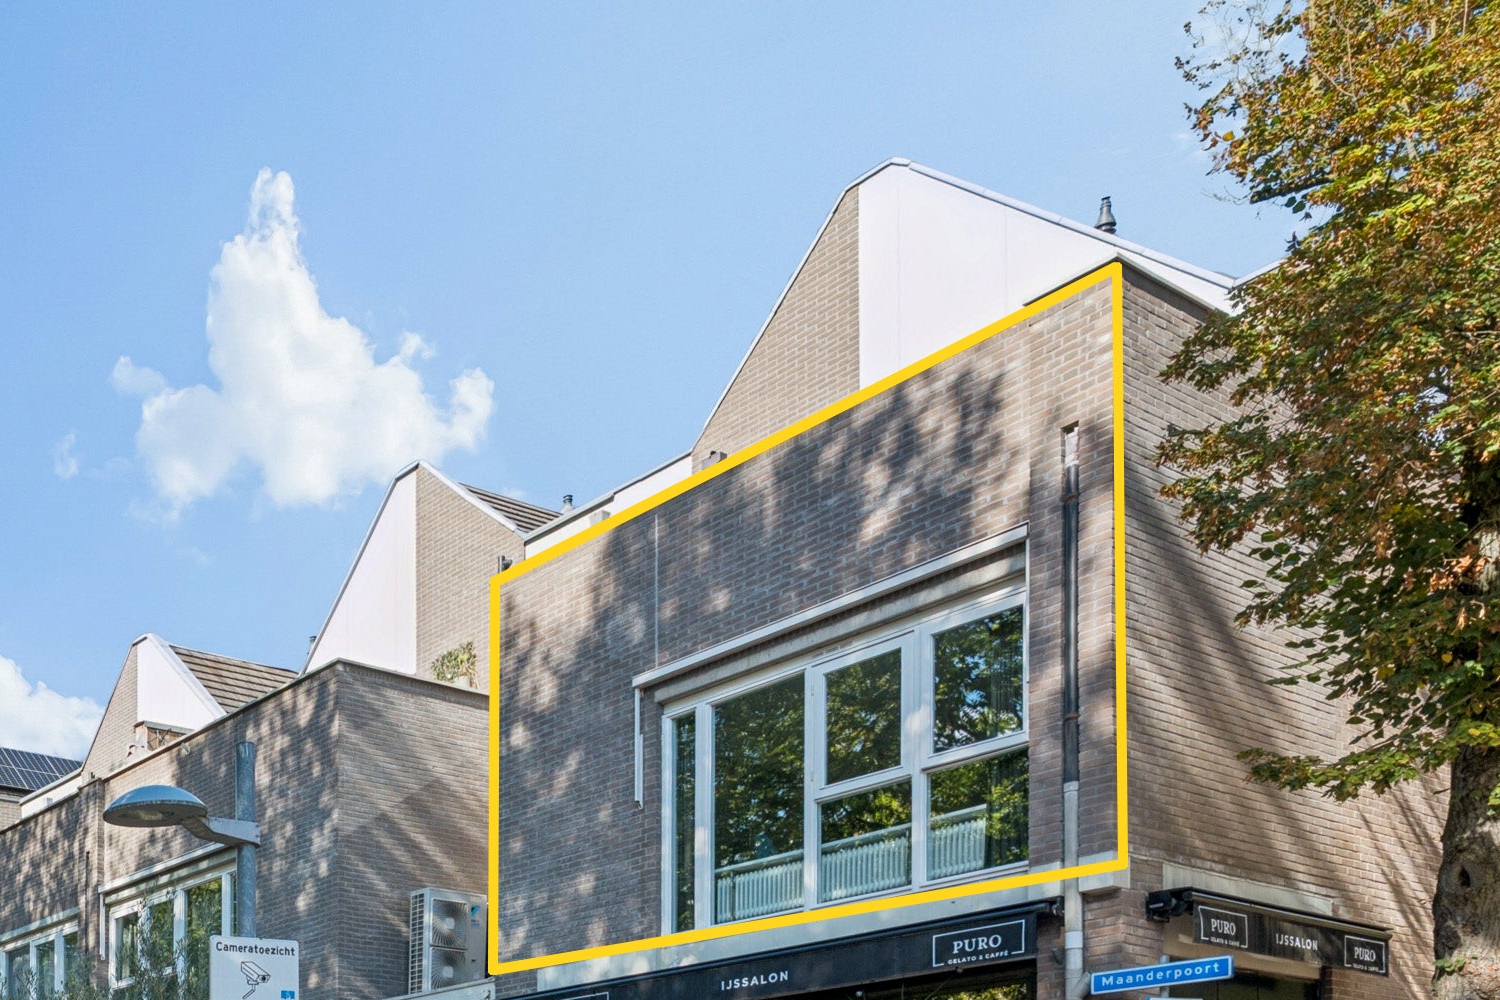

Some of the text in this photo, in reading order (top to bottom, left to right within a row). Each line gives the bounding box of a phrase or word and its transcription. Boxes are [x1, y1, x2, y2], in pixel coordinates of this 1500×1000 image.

[1210, 918, 1236, 936] PURO
[215, 941, 296, 957] Cameratoezicht
[952, 934, 1002, 954] PURO
[1275, 933, 1319, 951] IJSSALON
[947, 956, 977, 965] GELATO
[1354, 946, 1376, 962] PURO
[720, 970, 789, 991] IJSSALON
[1101, 960, 1220, 987] Maanderpoort
